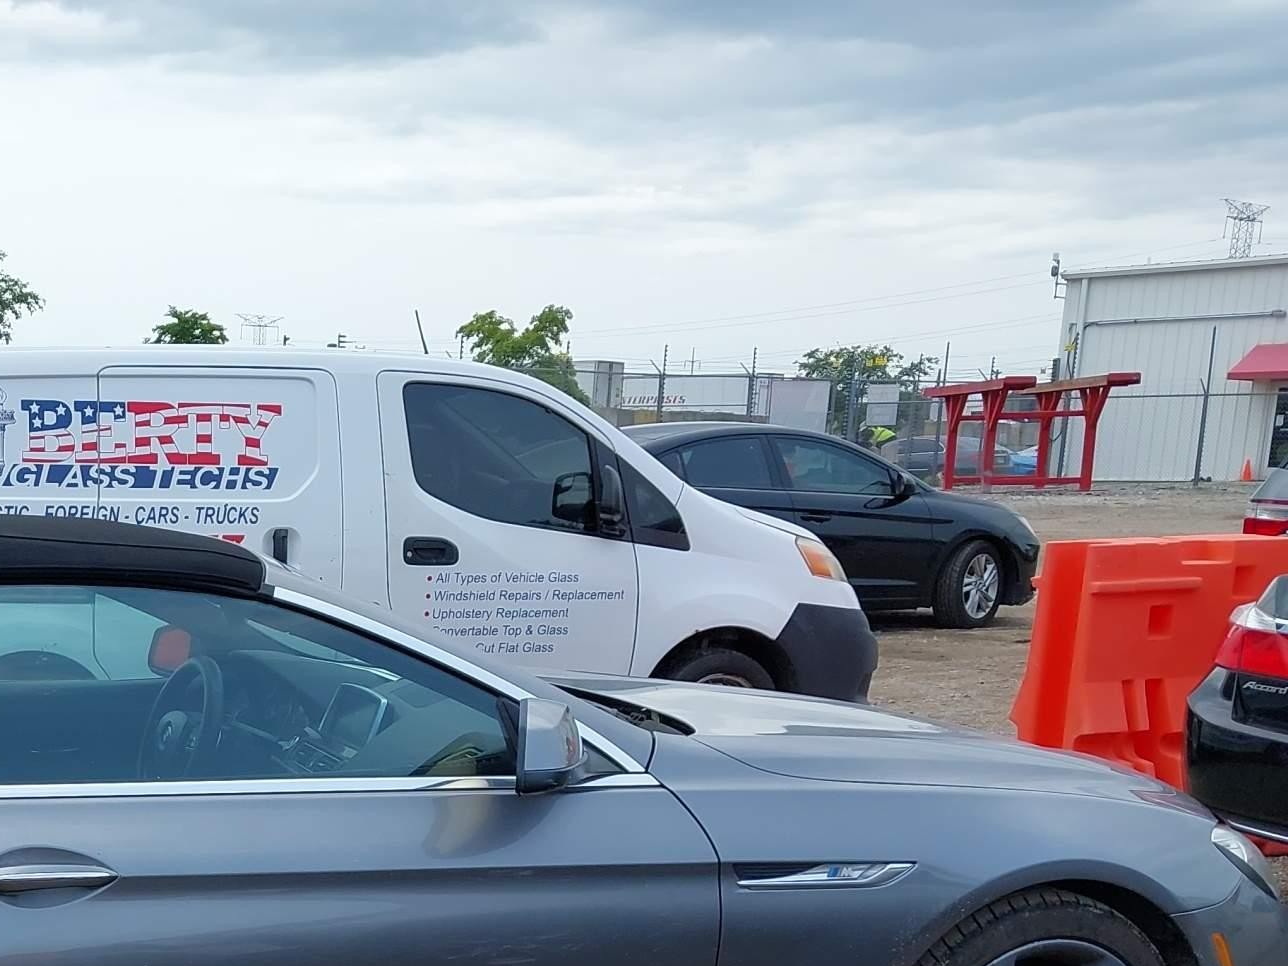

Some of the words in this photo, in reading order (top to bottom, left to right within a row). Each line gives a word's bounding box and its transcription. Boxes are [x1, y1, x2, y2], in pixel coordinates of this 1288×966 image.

[9, 464, 136, 489] GLASS
[148, 465, 270, 490] TECHS
[135, 506, 180, 525] CARS
[195, 504, 260, 525] TRUCKS
[435, 572, 451, 584] All
[454, 572, 487, 586] Types
[490, 572, 502, 583] of
[505, 572, 545, 583] Vehicle
[548, 571, 579, 583] Glass
[434, 590, 496, 601] Windshield
[499, 589, 542, 603] Repairs
[552, 589, 624, 603] Replacement
[432, 607, 492, 621] Upholstery
[496, 607, 569, 620] Replacement
[503, 624, 522, 638] Top
[525, 624, 533, 636] &
[537, 624, 569, 636] Glass
[498, 642, 519, 653] Flat
[522, 641, 554, 653] Glass
[1242, 681, 1288, 695] Accord
